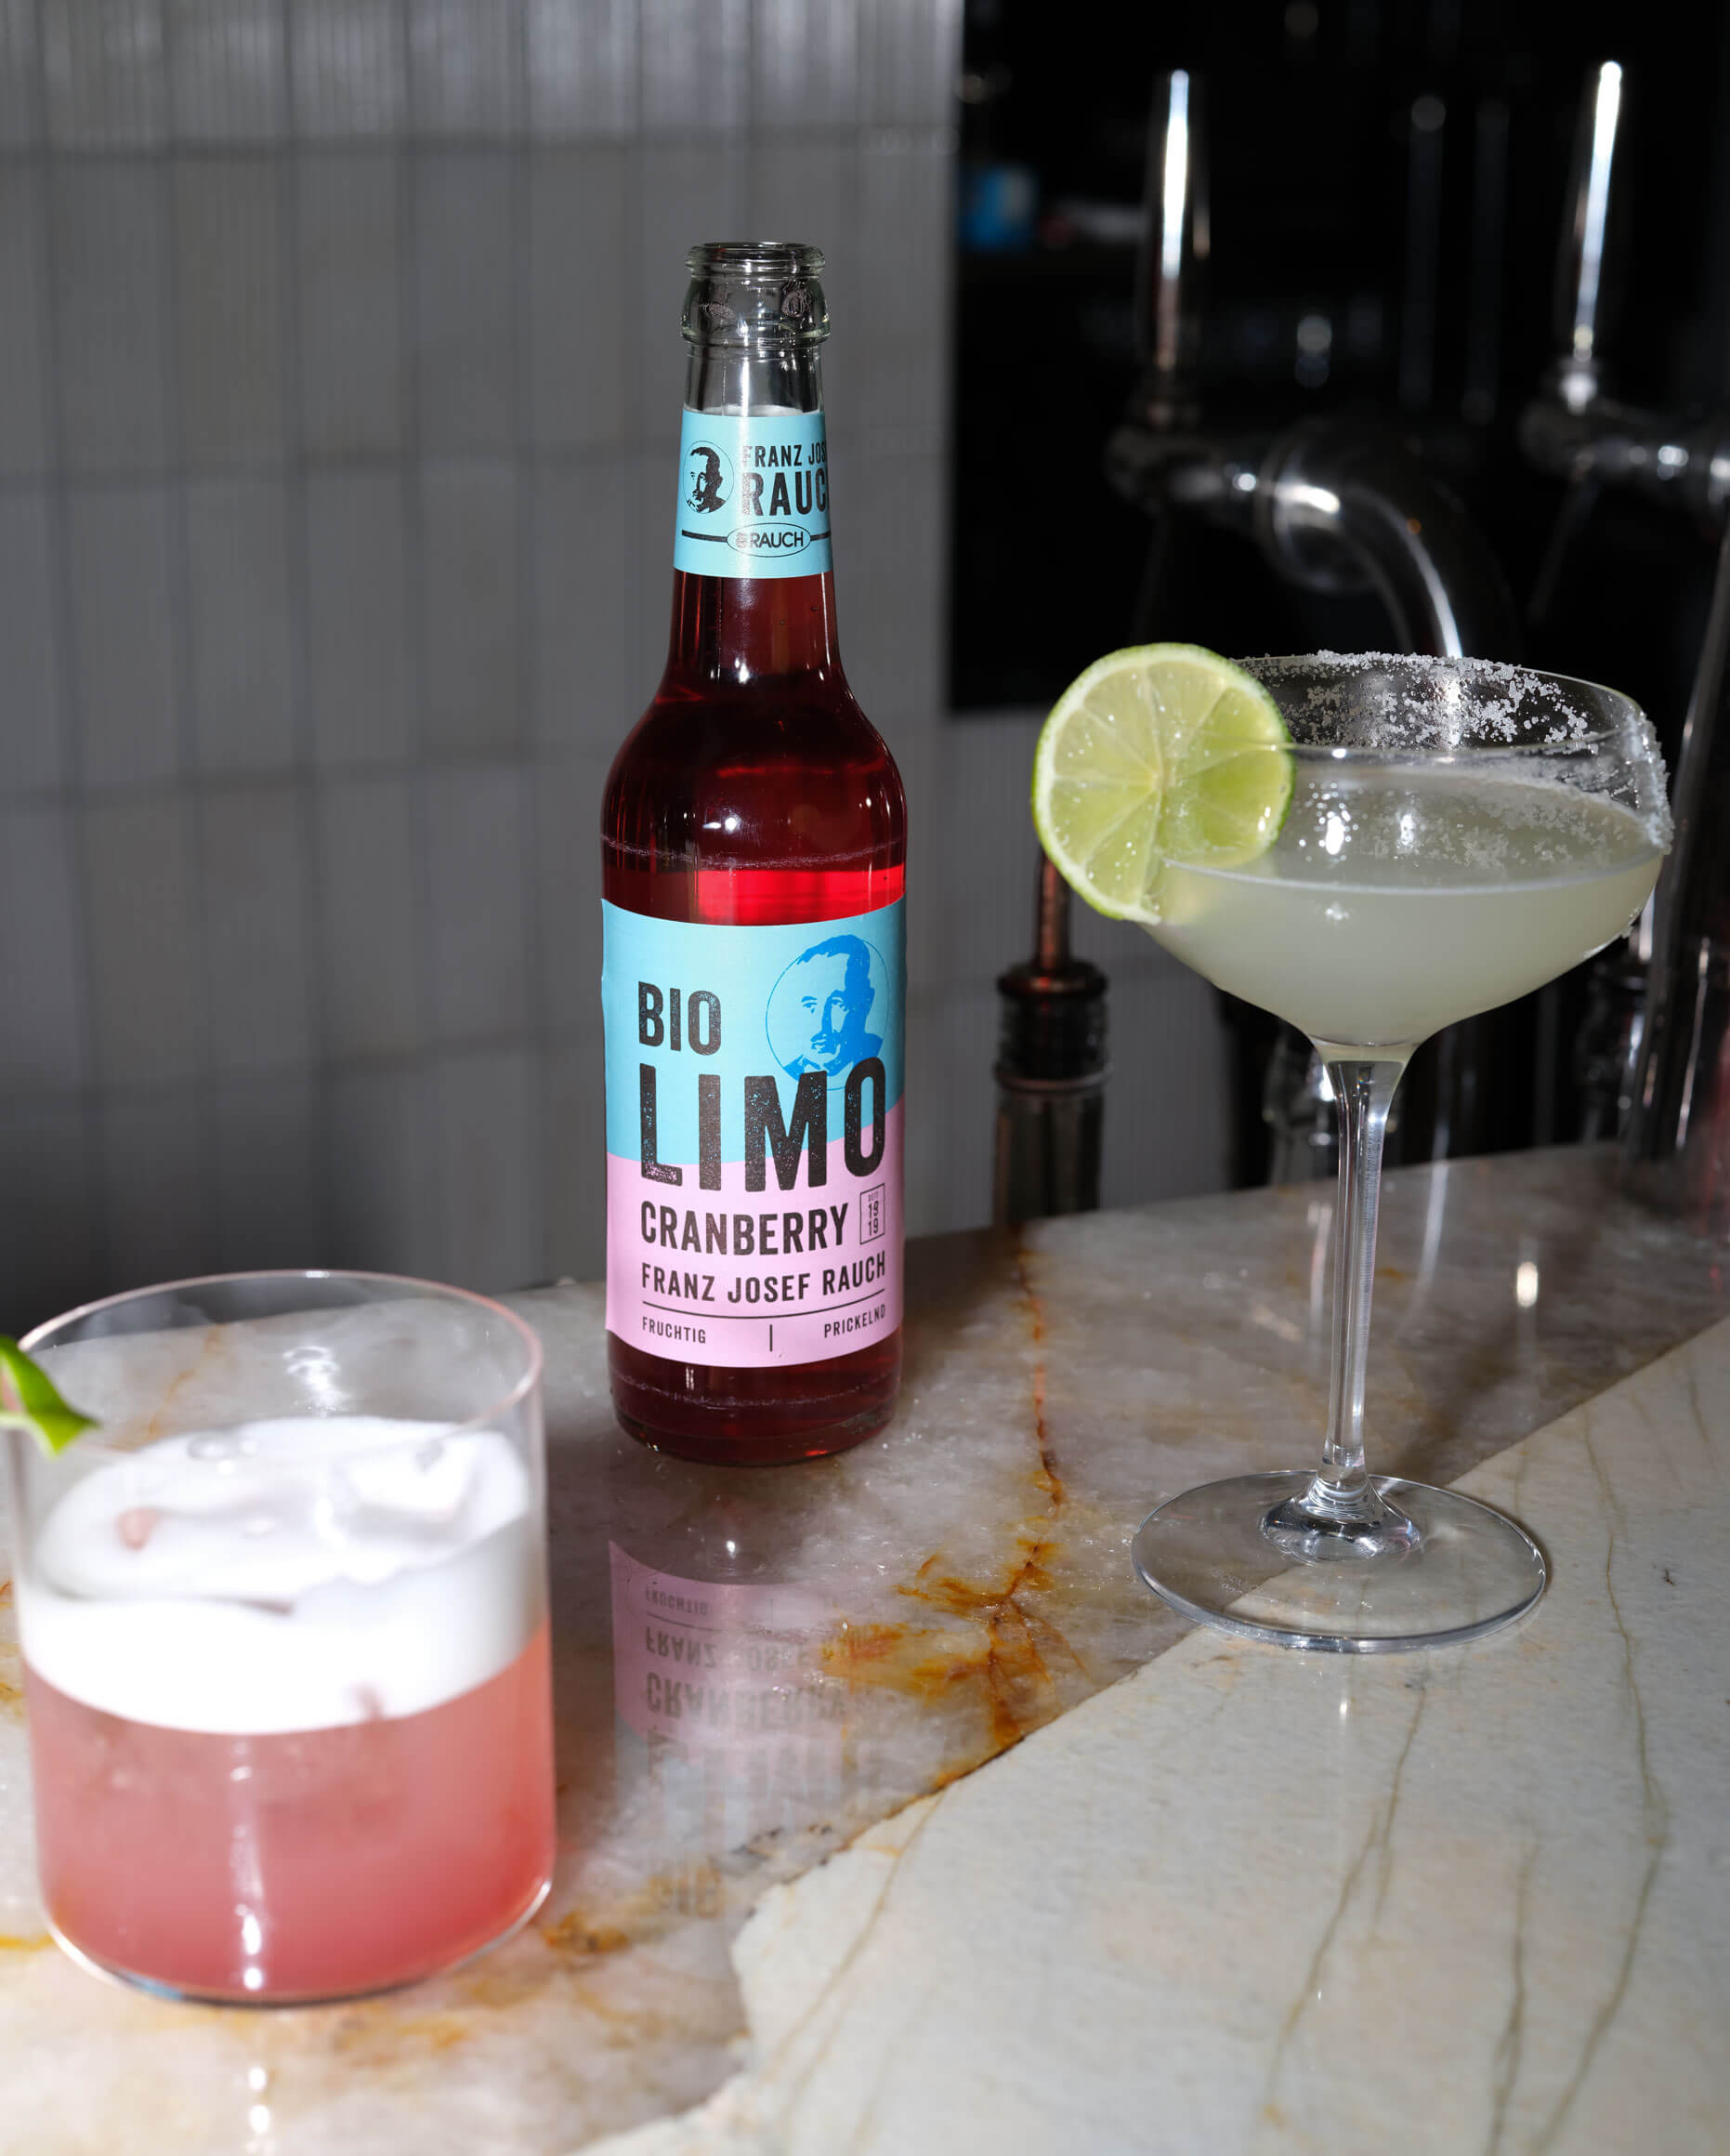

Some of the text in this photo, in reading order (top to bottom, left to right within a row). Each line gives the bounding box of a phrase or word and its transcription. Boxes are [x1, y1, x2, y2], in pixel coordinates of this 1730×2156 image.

[742, 440, 826, 467] FRANZ JOS
[741, 467, 828, 517] RAUC
[750, 531, 804, 548] RAUCH
[638, 980, 722, 1056] BIO
[639, 1057, 886, 1192] LIMO
[641, 1200, 849, 1255] CRANBERRY
[868, 1217, 879, 1236] 19
[642, 1251, 885, 1304] FRANZ JOSEF RAUCH
[642, 1303, 885, 1345] FRUCHTIG PRICKELND
